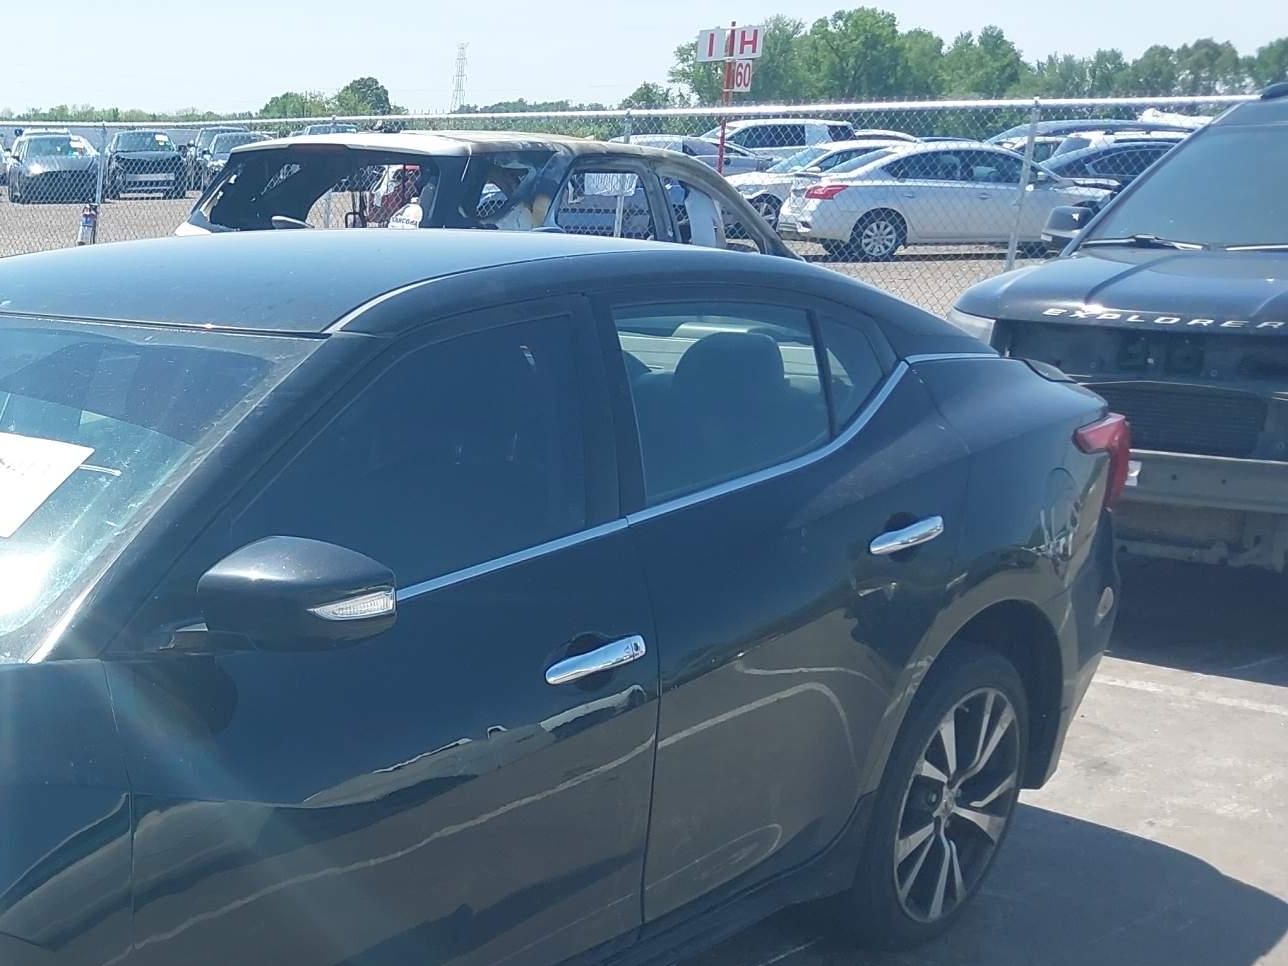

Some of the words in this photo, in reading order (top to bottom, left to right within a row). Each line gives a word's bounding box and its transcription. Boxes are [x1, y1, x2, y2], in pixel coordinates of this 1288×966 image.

[739, 29, 758, 54] H
[736, 63, 751, 87] 60
[1042, 308, 1286, 329] EXPLORER
